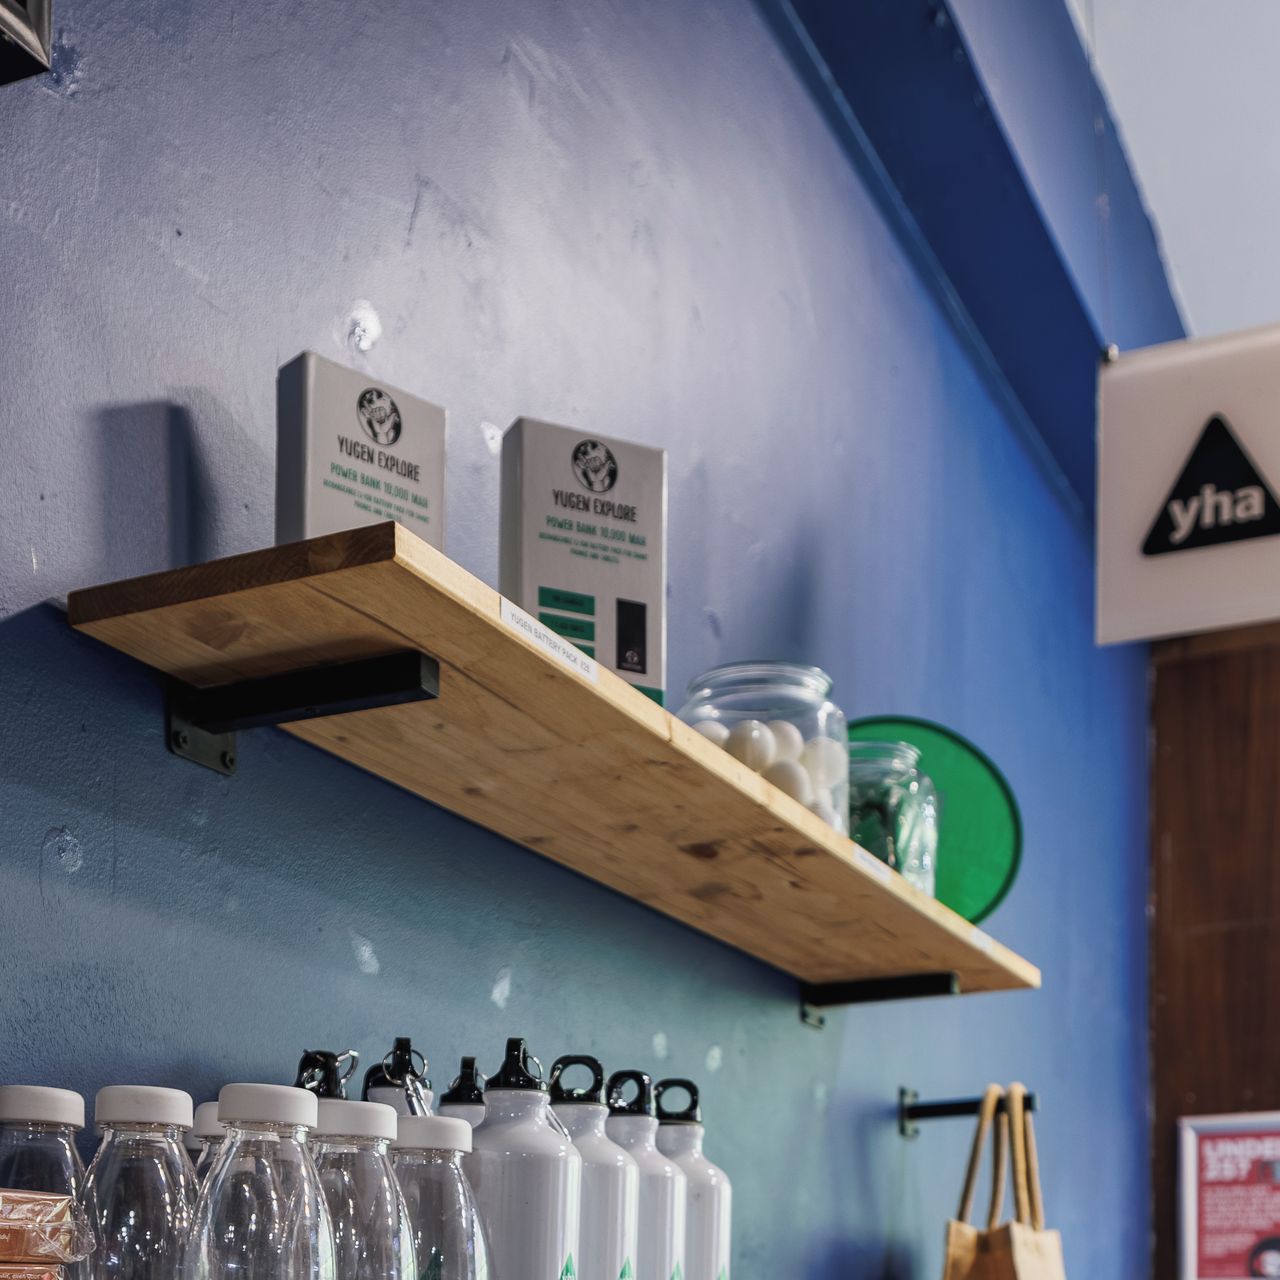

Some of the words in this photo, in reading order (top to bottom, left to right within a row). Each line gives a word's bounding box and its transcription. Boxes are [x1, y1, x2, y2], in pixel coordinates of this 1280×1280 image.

[330, 462, 357, 482] POWER
[361, 472, 381, 489] BANK
[337, 434, 374, 464] YUGEN
[378, 451, 420, 481] EXPLORE
[546, 515, 573, 531] POWER
[577, 521, 597, 535] BANK
[552, 489, 590, 512] YUGEN
[594, 498, 637, 522] EXPLORE
[1169, 478, 1264, 545] yha
[511, 608, 532, 633] YUGEN
[534, 627, 560, 653] BATTERY
